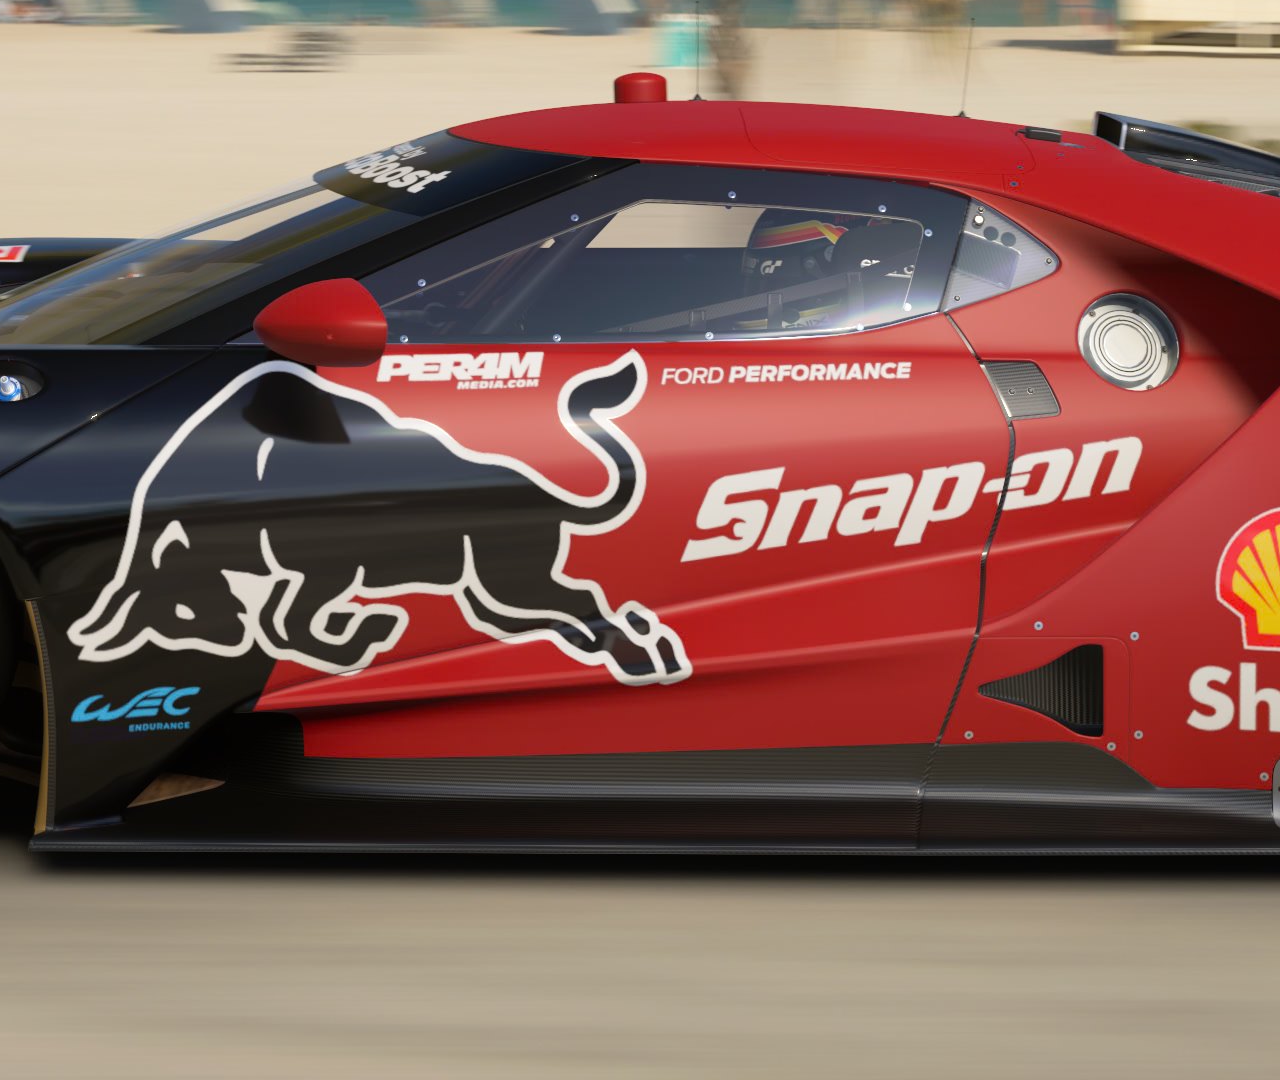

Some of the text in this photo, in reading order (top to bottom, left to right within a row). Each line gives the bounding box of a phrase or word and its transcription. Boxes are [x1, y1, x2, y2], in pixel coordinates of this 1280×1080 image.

[456, 379, 539, 390] MEDIA.COM
[661, 362, 912, 385] FORD PERFORMANCE
[681, 436, 1143, 562] Snap-on
[71, 686, 201, 722] WEC
[128, 721, 191, 732] ENDURANCE
